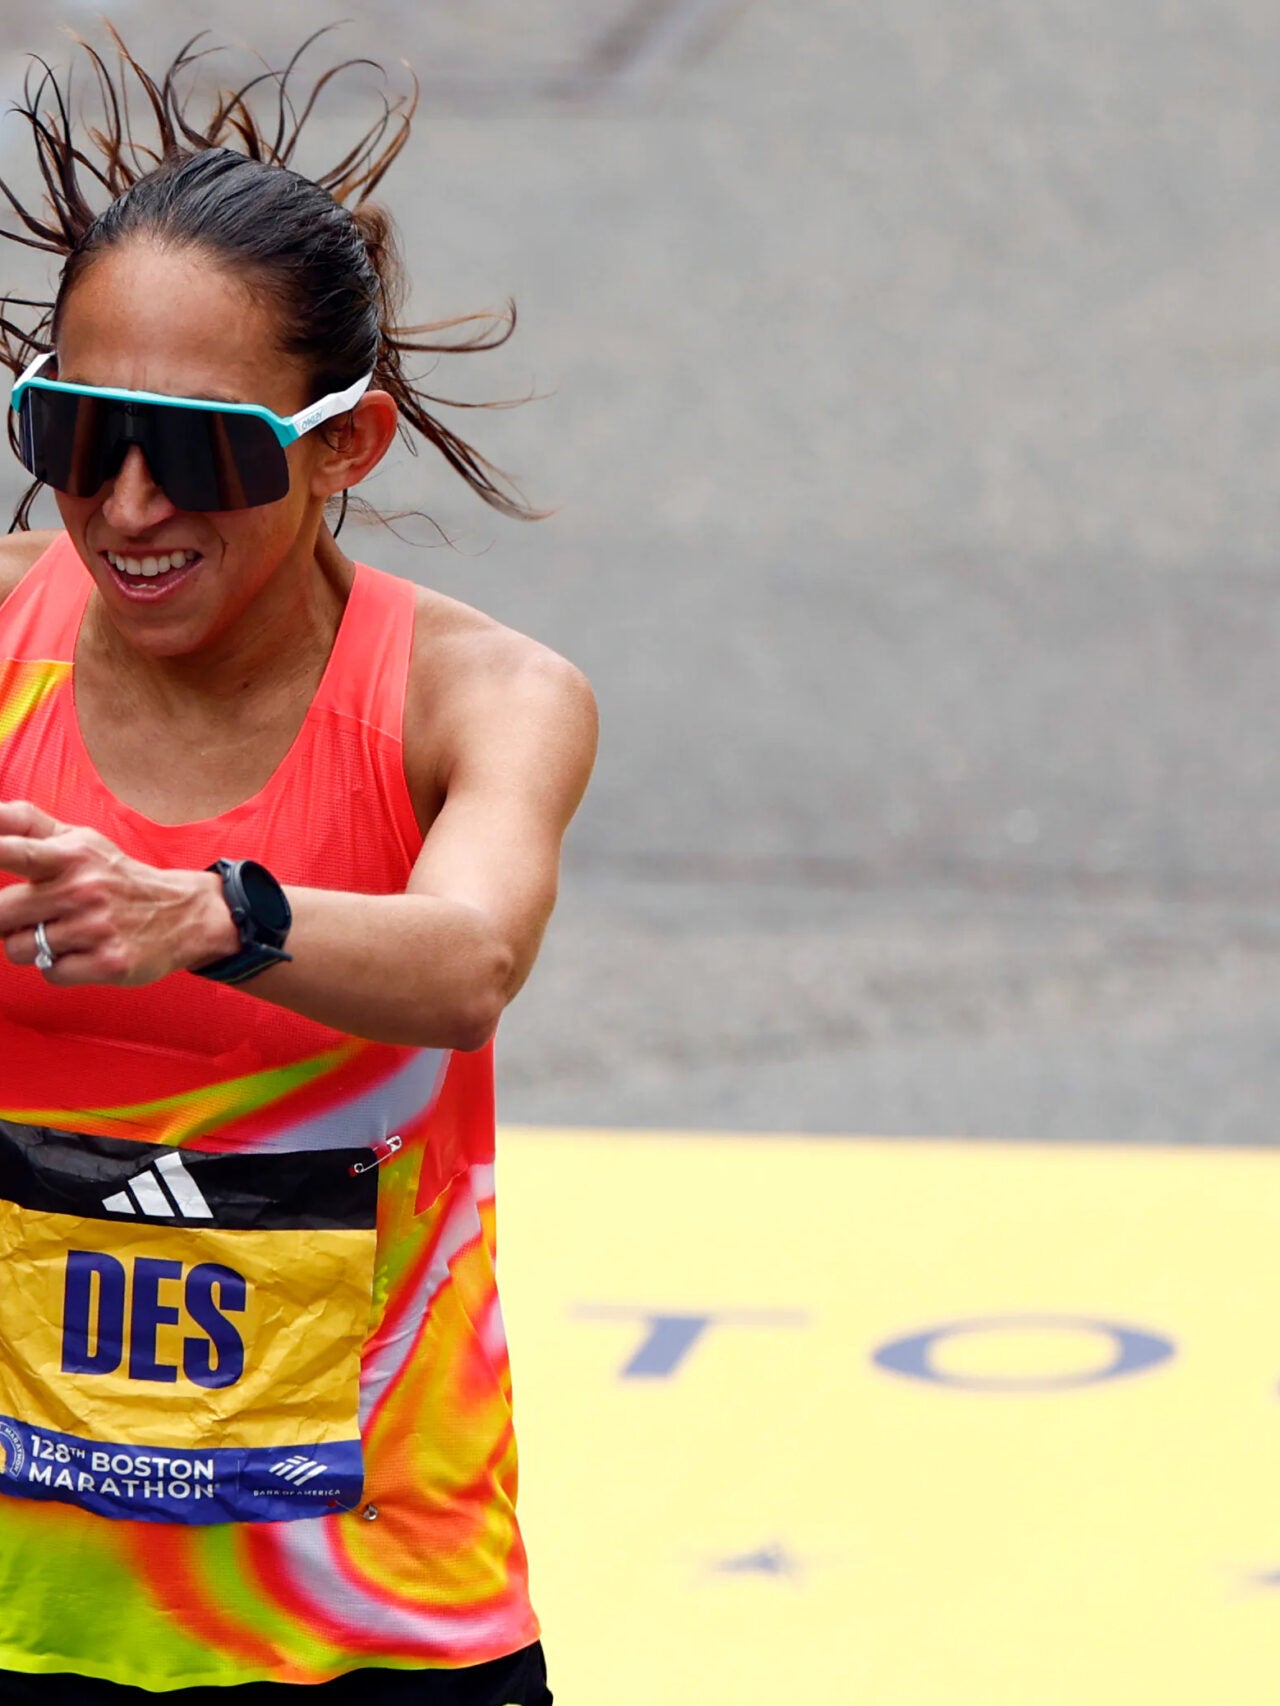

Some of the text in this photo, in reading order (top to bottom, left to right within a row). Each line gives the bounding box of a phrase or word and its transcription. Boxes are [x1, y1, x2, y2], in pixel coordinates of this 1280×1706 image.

[61, 1249, 247, 1390] DES
[28, 1461, 214, 1500] MARATHON
[30, 1434, 214, 1481] 128TH BOSTON
